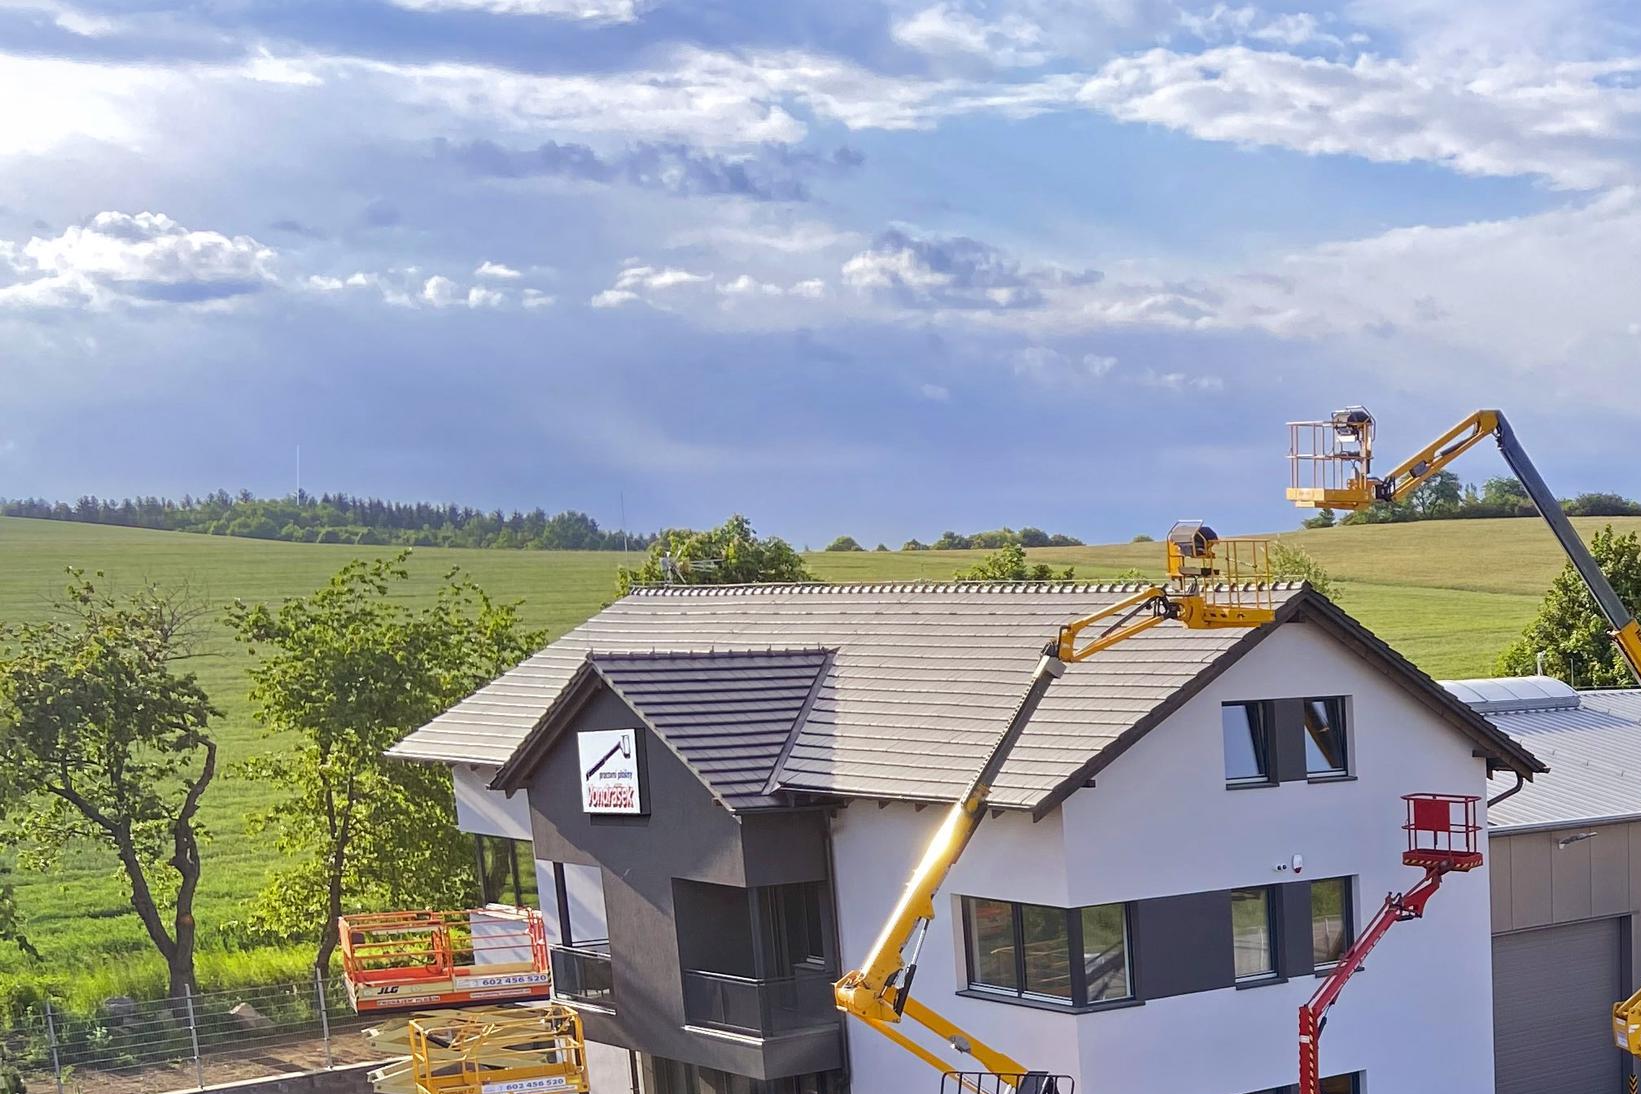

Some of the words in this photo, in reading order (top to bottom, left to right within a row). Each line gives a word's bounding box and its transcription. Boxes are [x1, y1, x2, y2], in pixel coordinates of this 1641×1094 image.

[482, 978, 501, 986] 602
[505, 977, 525, 985] 456
[527, 974, 547, 982] 520
[377, 986, 400, 995] JLG
[506, 1083, 525, 1091] 602
[526, 1081, 545, 1089] 456
[546, 1078, 564, 1086] 520
